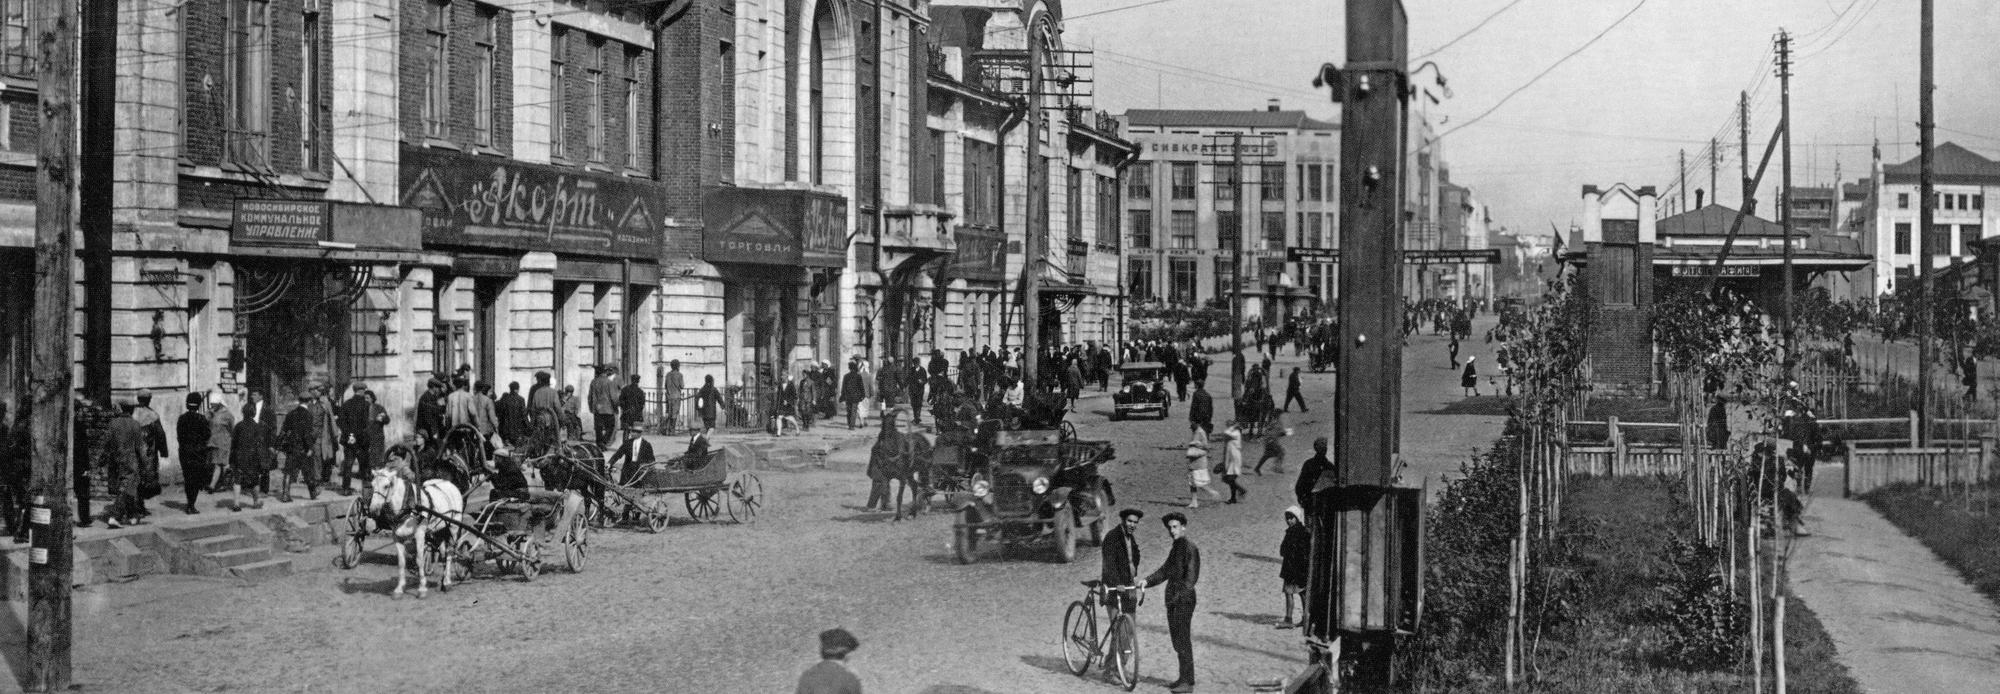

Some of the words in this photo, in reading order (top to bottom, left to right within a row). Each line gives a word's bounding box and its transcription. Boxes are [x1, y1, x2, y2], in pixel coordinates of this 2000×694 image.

[242, 203, 320, 214] НОВОСИБИРСКОЕ
[241, 213, 321, 225] КОММУНАЛЬНОЕ
[425, 217, 453, 228] ОВЛИ
[245, 225, 319, 239] УПРАВЛЕНИЕ
[720, 240, 791, 252] ТОРГОВЛИ
